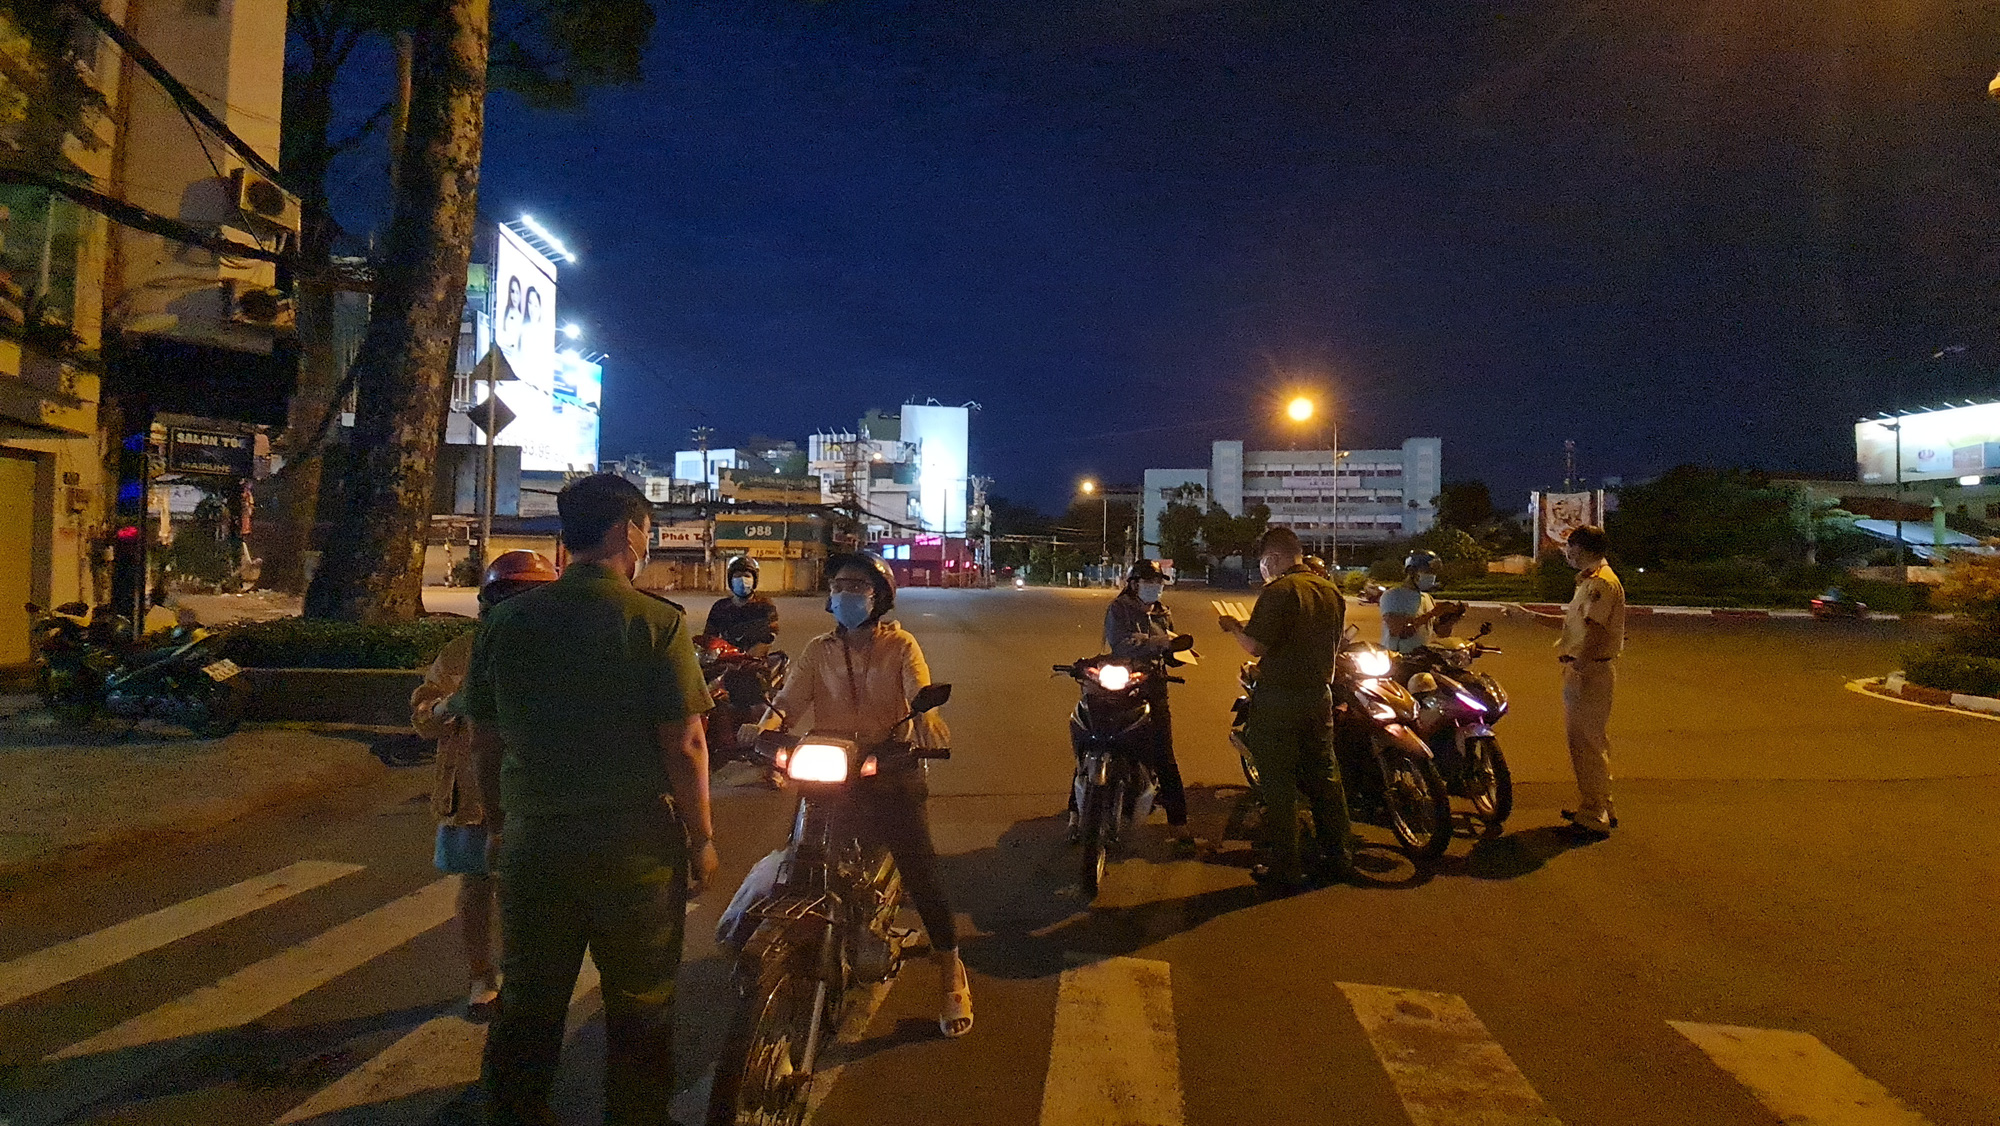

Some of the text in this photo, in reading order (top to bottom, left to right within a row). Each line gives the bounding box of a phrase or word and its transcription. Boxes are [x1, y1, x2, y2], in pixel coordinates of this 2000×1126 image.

[177, 434, 217, 446] SALON
[662, 532, 689, 541] Phát
[744, 525, 772, 537] F88
